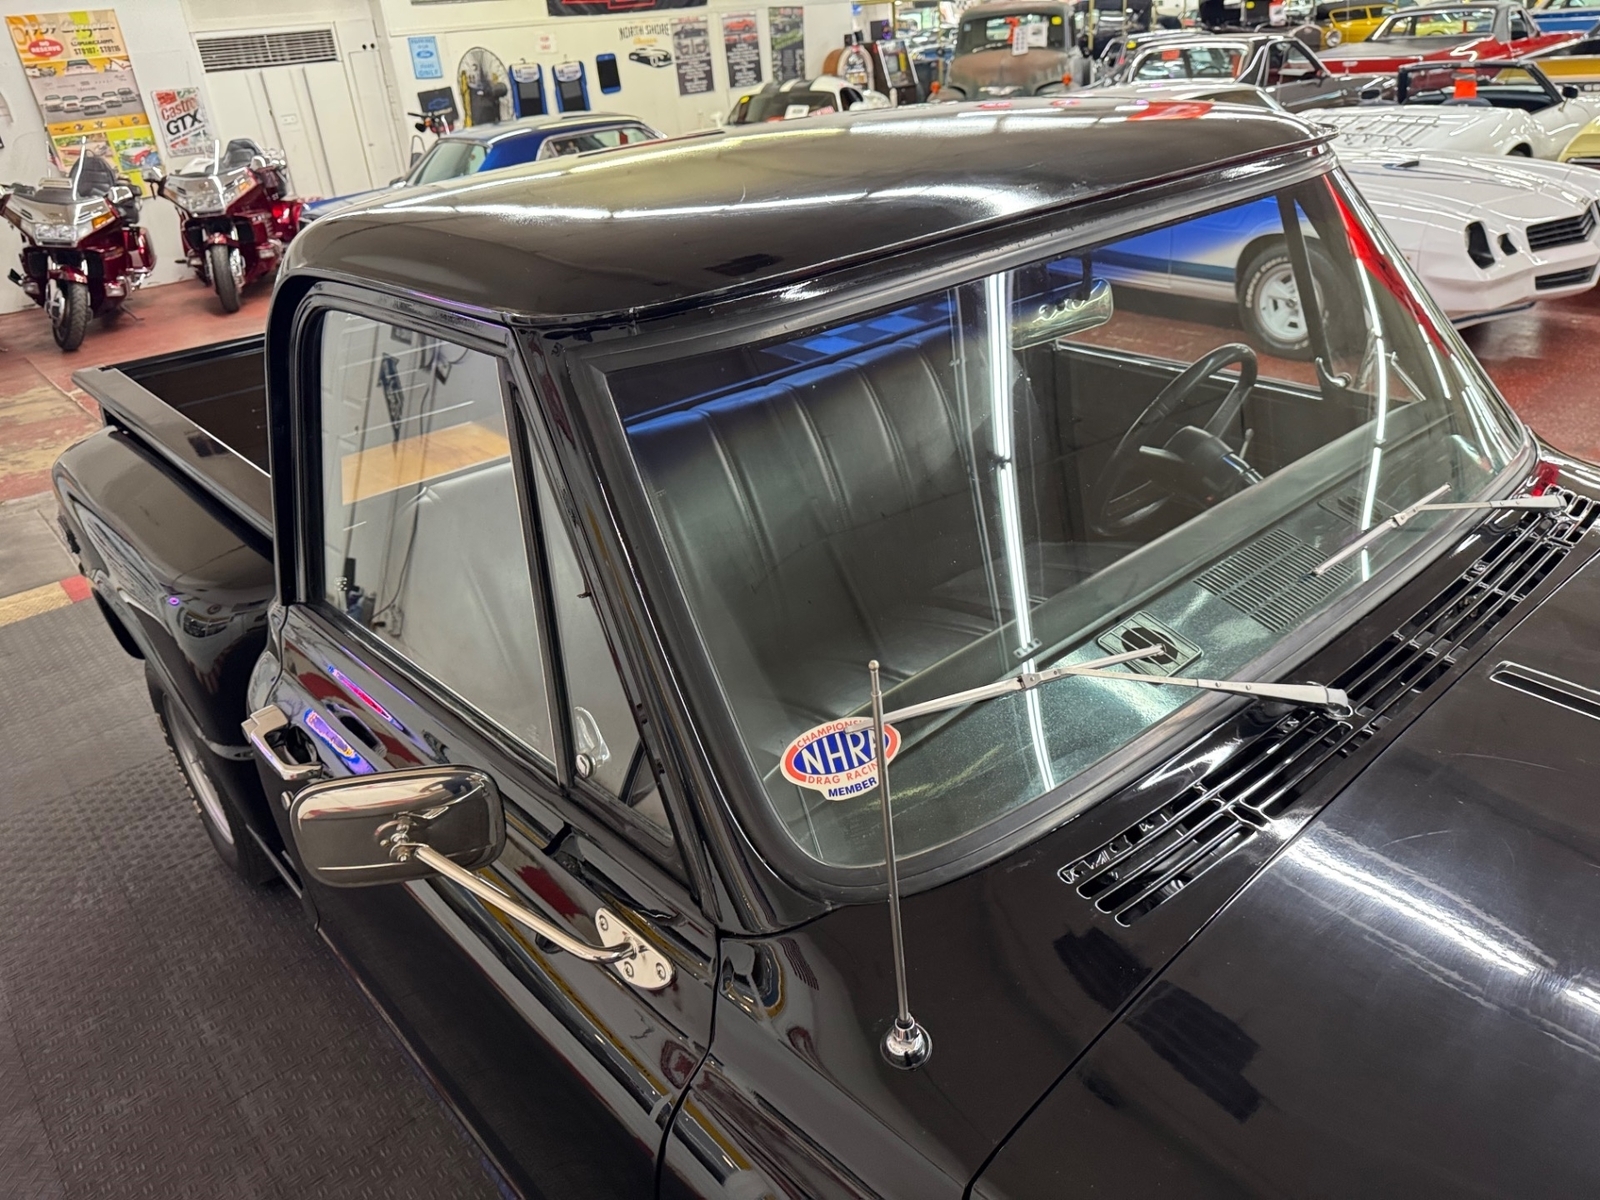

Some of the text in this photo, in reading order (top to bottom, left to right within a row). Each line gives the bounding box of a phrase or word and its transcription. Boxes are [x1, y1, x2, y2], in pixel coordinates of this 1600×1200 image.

[161, 95, 199, 121] Castro
[166, 108, 202, 136] GTX
[808, 762, 878, 785] DRAG RACIN
[828, 777, 877, 797] MEMBER
